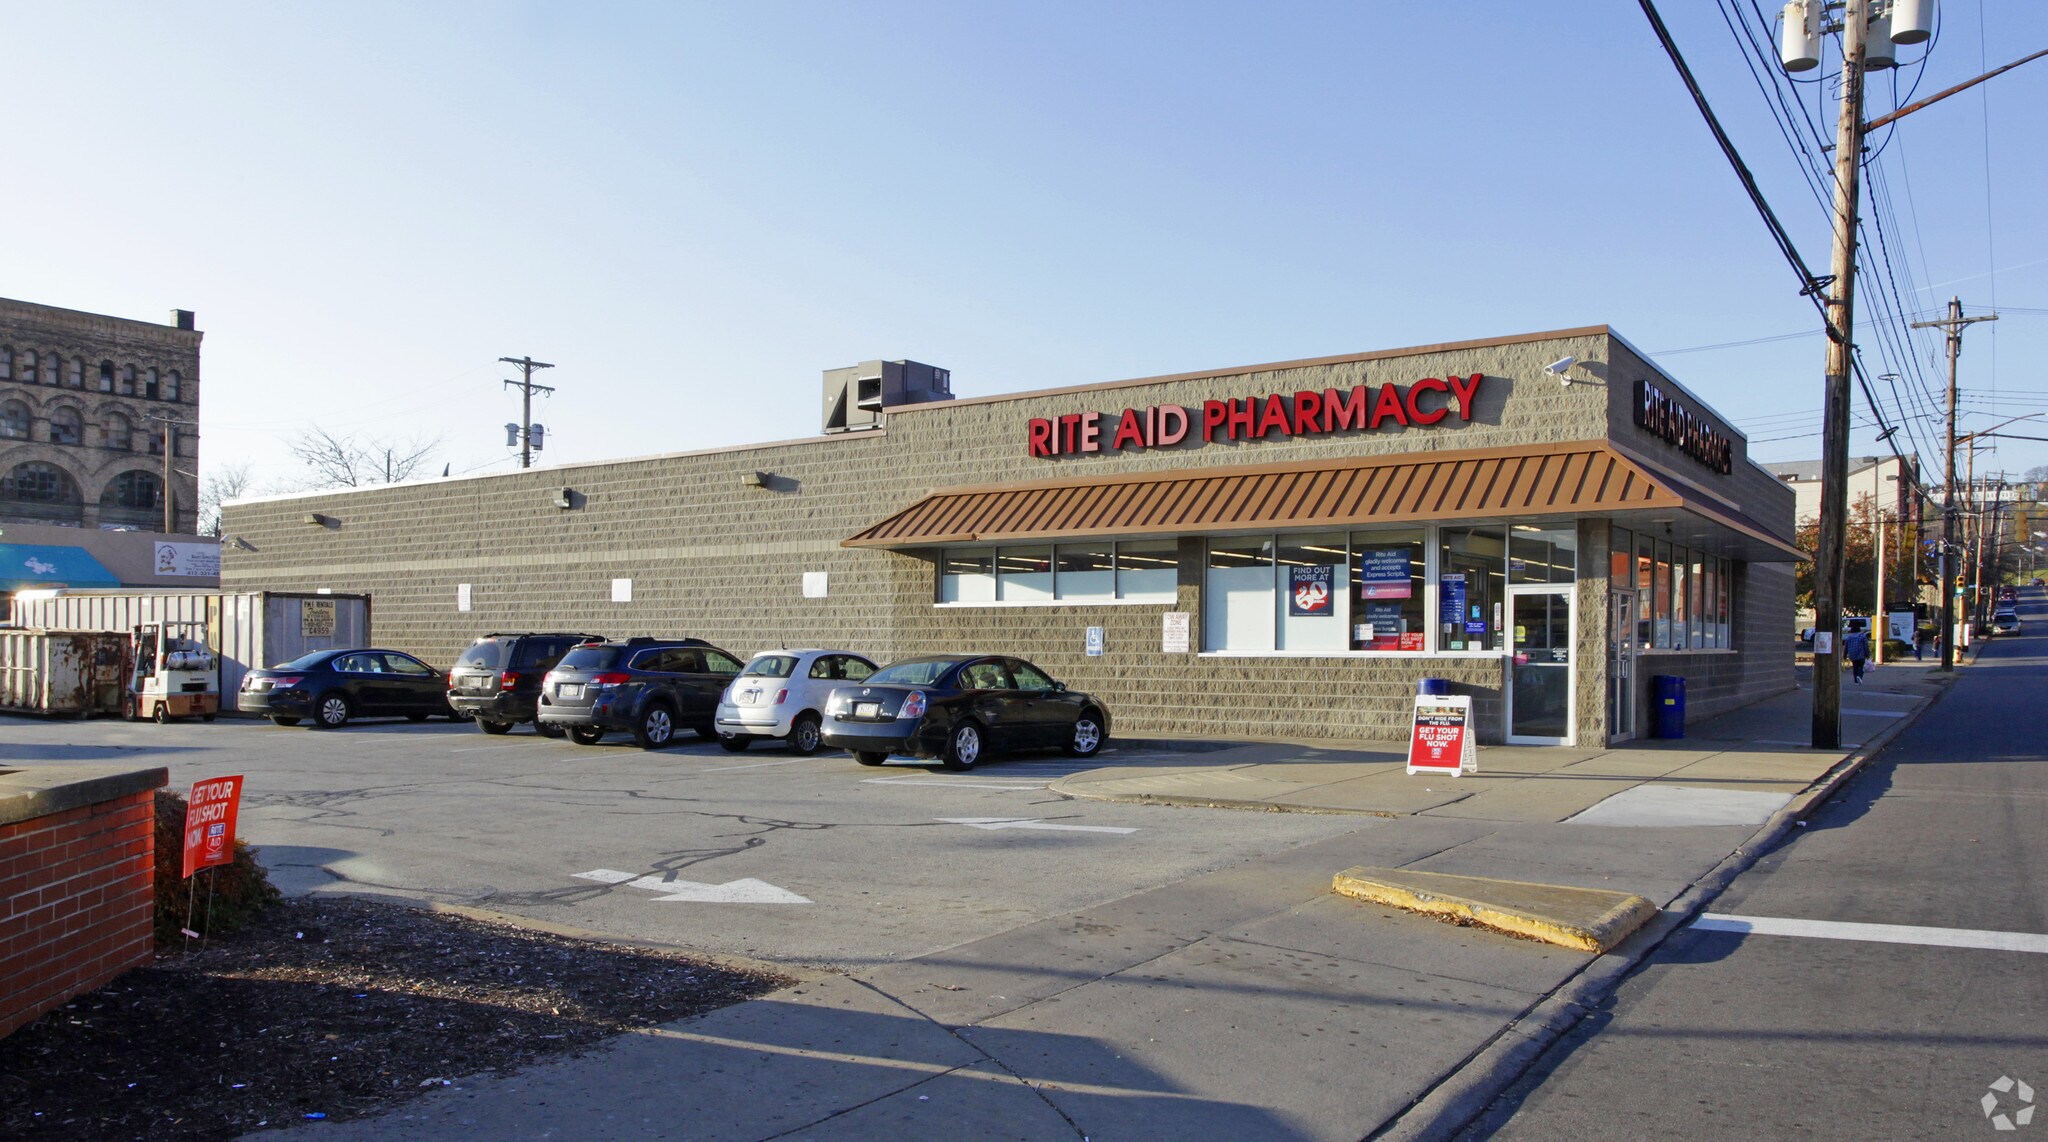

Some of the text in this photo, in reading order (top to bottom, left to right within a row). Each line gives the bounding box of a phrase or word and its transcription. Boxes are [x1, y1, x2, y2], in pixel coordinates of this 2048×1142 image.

[1029, 373, 1482, 457] RITE AID PHARMACY
[1637, 380, 1665, 438] RITE
[1314, 566, 1330, 574] OUT
[192, 781, 234, 804] GET YOUR
[189, 802, 228, 826] FLU SHOT
[210, 825, 223, 835] RITE
[209, 837, 221, 847] AID
